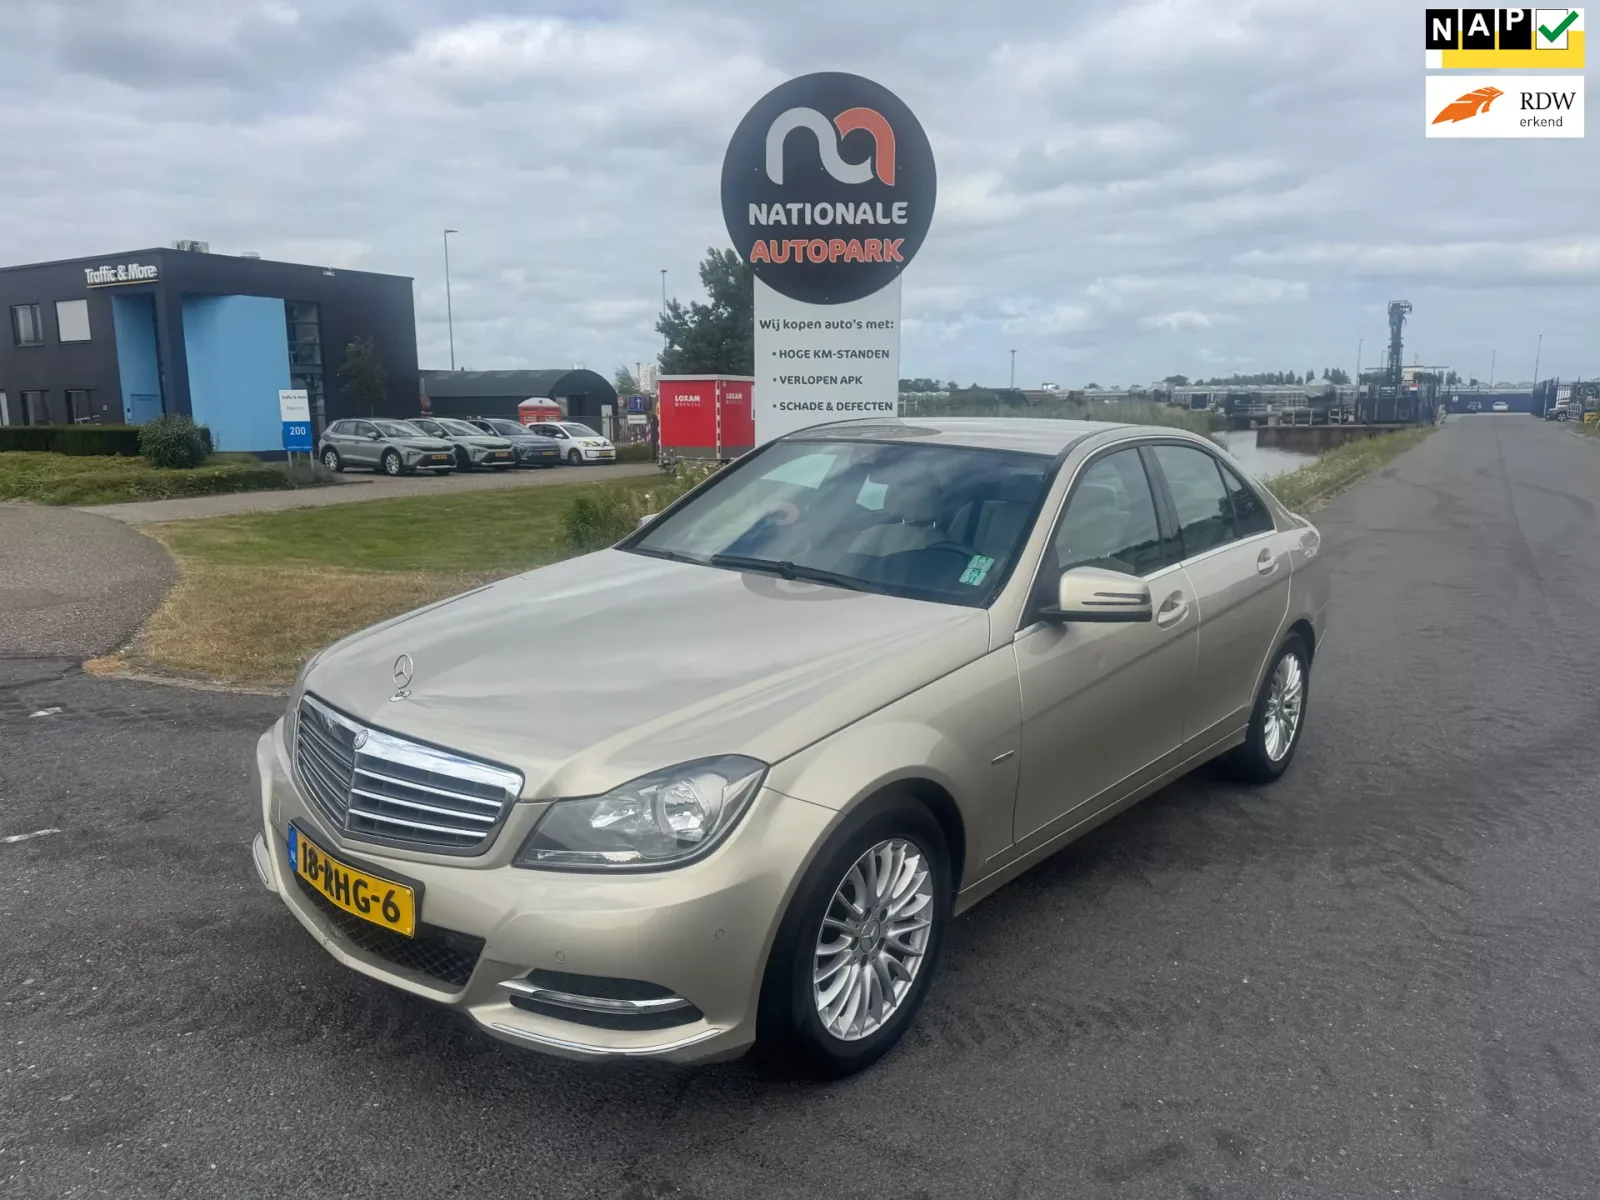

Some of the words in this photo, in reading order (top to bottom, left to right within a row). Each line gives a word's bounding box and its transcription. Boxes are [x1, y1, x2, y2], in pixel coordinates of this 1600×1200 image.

[748, 202, 909, 226] NATIONALE
[749, 238, 905, 263] AUTOPARK
[84, 265, 118, 284] Traffic
[117, 264, 128, 281] &
[127, 263, 158, 280] More
[759, 319, 780, 331] Wij
[783, 319, 822, 331] kopen
[824, 319, 863, 330] auto's
[865, 319, 894, 329] met:
[779, 349, 811, 359] HOGE
[813, 349, 890, 359] KM-STANDEN
[779, 375, 838, 385] VERLOPEN
[839, 375, 863, 385] APK
[674, 394, 701, 402] LOXAM
[779, 401, 824, 411] SCHADE
[825, 401, 834, 411] &
[836, 401, 893, 411] DEFECTEN
[289, 426, 307, 436] 200
[301, 842, 401, 924] 18-RHG-6
